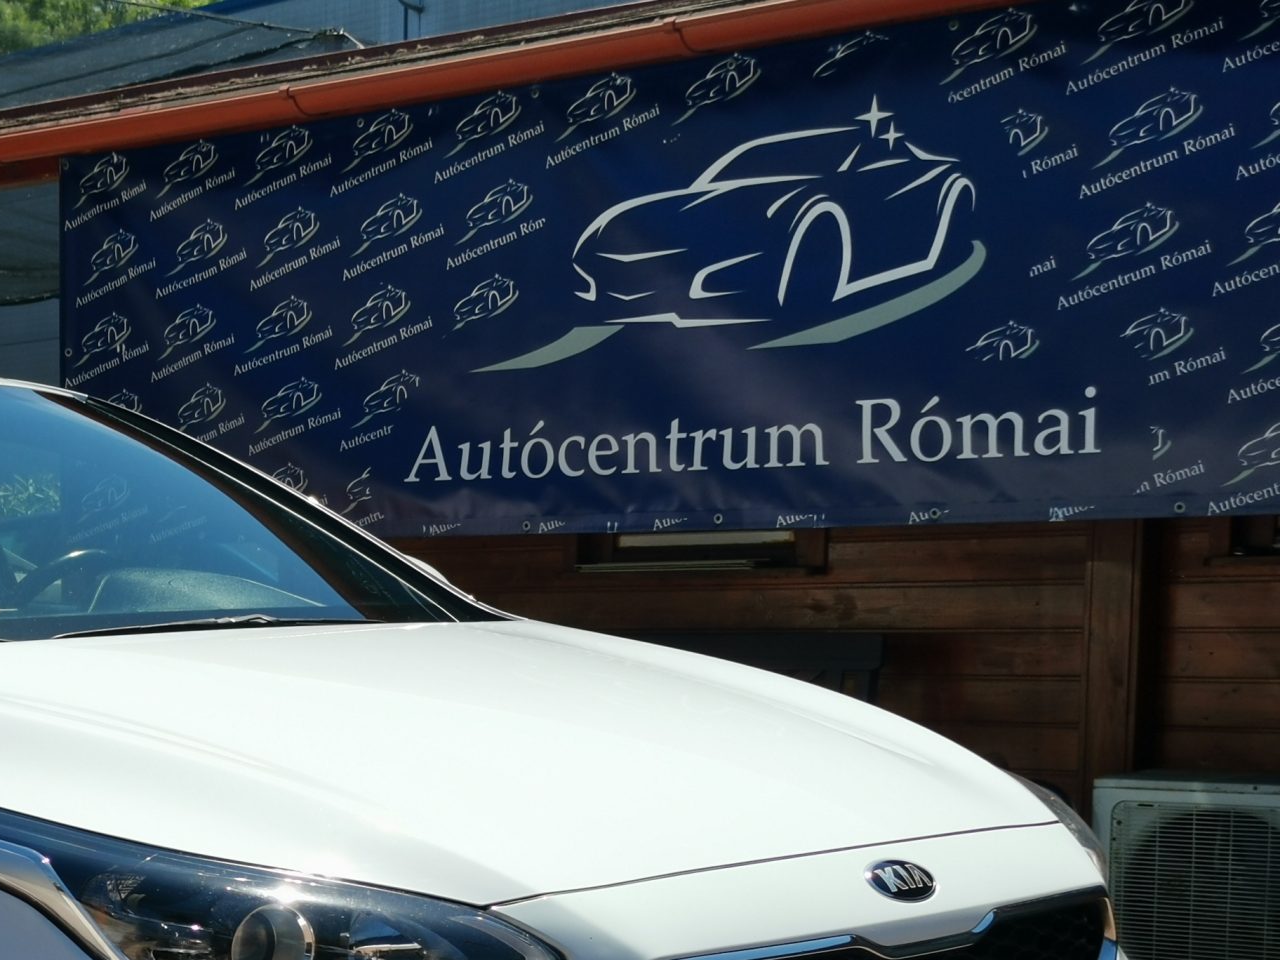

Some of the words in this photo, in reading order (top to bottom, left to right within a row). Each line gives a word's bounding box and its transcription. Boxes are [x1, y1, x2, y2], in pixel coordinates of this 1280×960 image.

[1019, 40, 1066, 72] Római
[1066, 42, 1166, 96] Autócentrum
[1171, 16, 1225, 49] Római
[433, 143, 505, 184] Autócentrum
[508, 120, 545, 148] Római
[545, 128, 620, 169] Autócentrum
[623, 104, 660, 131] Római
[1031, 143, 1079, 175] Római
[1079, 149, 1179, 199] Autócentrum
[1184, 123, 1236, 155] Római
[234, 172, 297, 210] Autócentrum
[299, 154, 333, 178] Római
[329, 157, 396, 198] Autócentrum
[399, 137, 433, 162] Római
[64, 198, 120, 231] Autócentrum
[121, 179, 147, 203] Római
[149, 185, 203, 222] Autócentrum
[205, 167, 236, 190] Római
[155, 266, 218, 299] Autócentrum
[219, 248, 247, 271] Római
[249, 255, 308, 291] Autócentrum
[309, 236, 341, 261] Római
[342, 245, 408, 281] Autócentrum
[410, 223, 445, 249] Római
[446, 233, 517, 270] Autócentrum
[1057, 262, 1156, 310] Autócentrum
[1160, 239, 1212, 271] Római
[75, 274, 127, 308] Autócentrum
[128, 258, 156, 280] Római
[150, 349, 202, 383] Autócentrum
[203, 333, 235, 355] Római
[233, 344, 300, 376] Autócentrum
[302, 325, 333, 347] Római
[334, 334, 398, 370] Autócentrum
[399, 316, 433, 341] Római
[1174, 347, 1226, 377] Római
[218, 413, 245, 435] Római
[248, 423, 304, 456] Autócentrum
[307, 408, 342, 430] Római
[403, 416, 829, 483] Autócentrum
[856, 385, 1102, 464] Római
[1153, 460, 1205, 488] Római
[873, 864, 932, 892] KIA
